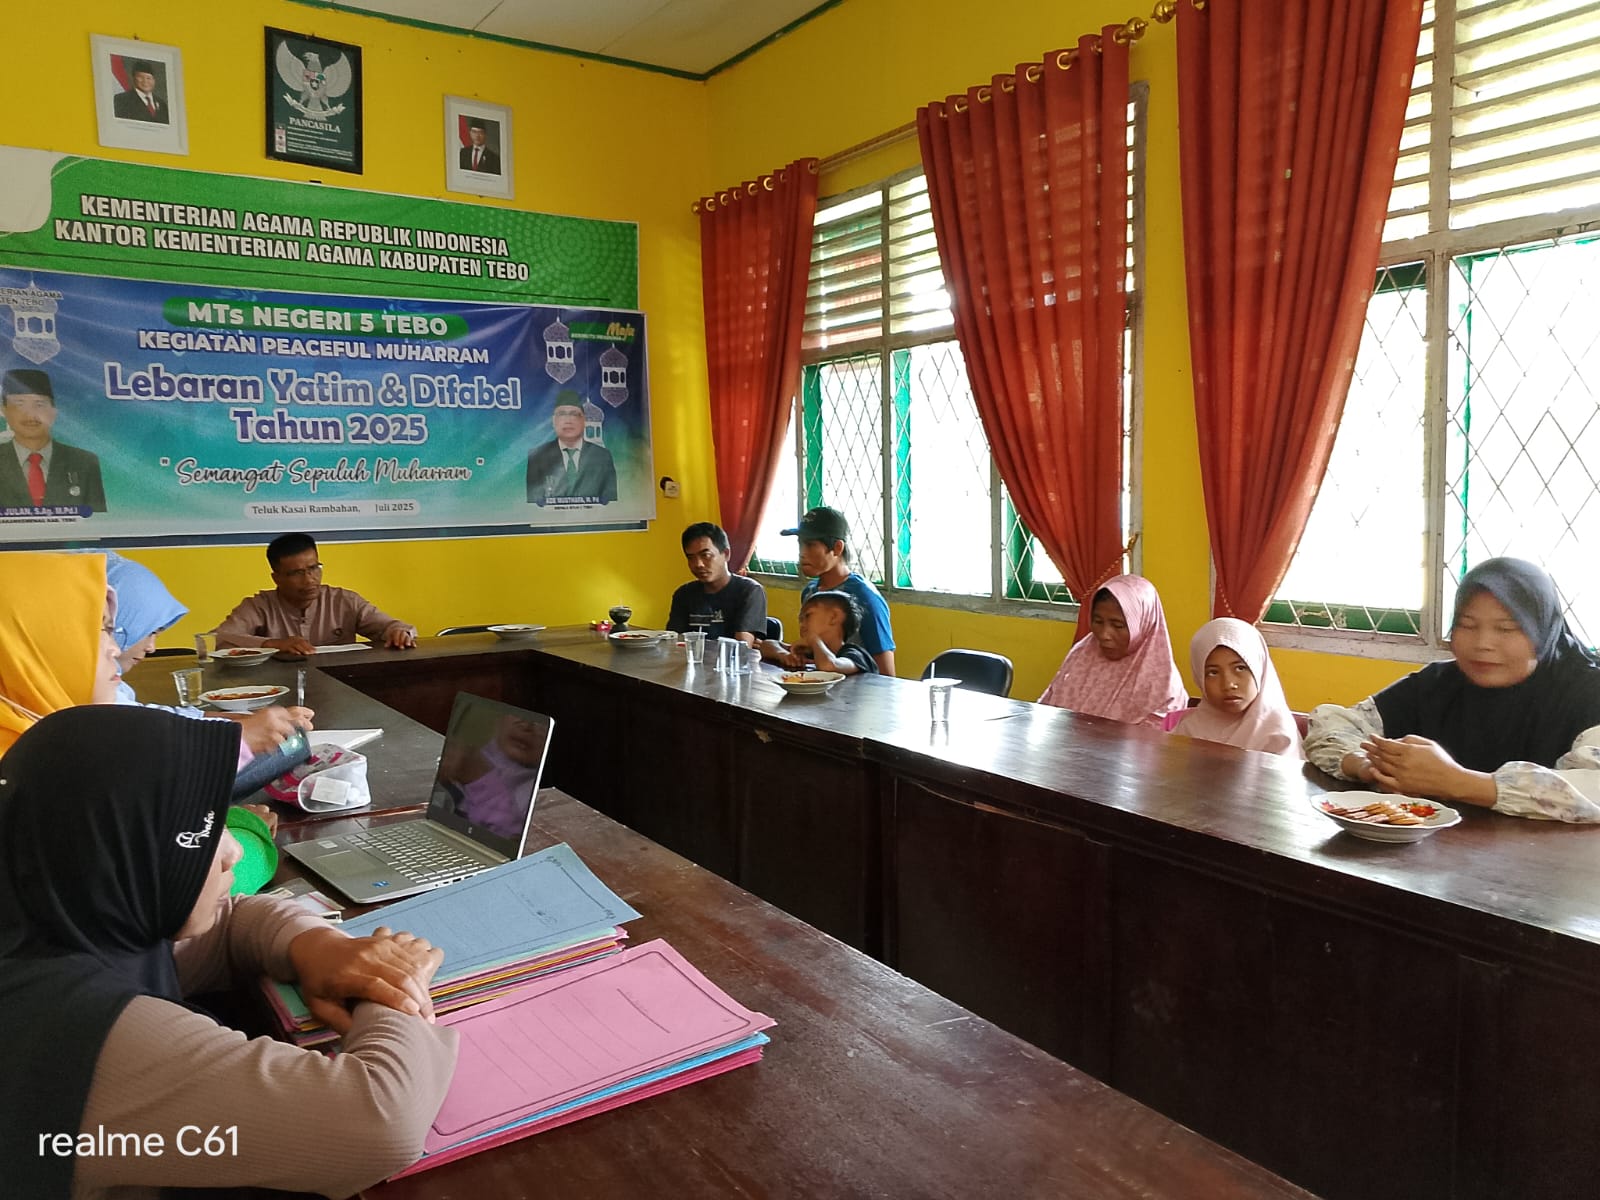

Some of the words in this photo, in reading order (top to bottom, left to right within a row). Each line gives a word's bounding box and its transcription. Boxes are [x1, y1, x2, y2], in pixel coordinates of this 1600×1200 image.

[288, 117, 341, 133] PANCASILA
[80, 194, 236, 229] KEMENTERIAN
[242, 211, 314, 237] AGAMA
[319, 219, 412, 246] REPUBLIK
[416, 230, 509, 256] INDONESIA
[55, 219, 147, 247] KANTOR
[153, 229, 300, 260] KEMENTERIAN
[306, 243, 375, 267] AGAMA
[380, 250, 482, 276] KABUPATEN
[486, 260, 529, 281] TEBO
[0, 288, 28, 296] ERIAN
[188, 302, 244, 324] MTs
[253, 306, 352, 331] NEGERI
[360, 313, 374, 332] 5
[381, 314, 448, 336] TEBO
[139, 330, 257, 353] KEGIATAN
[262, 338, 372, 359] PEACEFUL
[376, 344, 490, 363] MUHARRAM
[104, 362, 263, 403] Lebaran
[267, 368, 373, 406] Yatim
[378, 373, 407, 407] &
[410, 374, 521, 409] Difabel
[230, 407, 343, 443] Tahun
[347, 413, 428, 444] 2025
[175, 457, 285, 493] Semangat
[288, 457, 370, 493] Sepuluh
[374, 457, 472, 484] Muharram
[252, 505, 279, 514] Teluk
[281, 504, 307, 514] Kasai
[309, 503, 361, 514] Rambahan,
[375, 503, 390, 513] Juli
[392, 502, 414, 512] 2025
